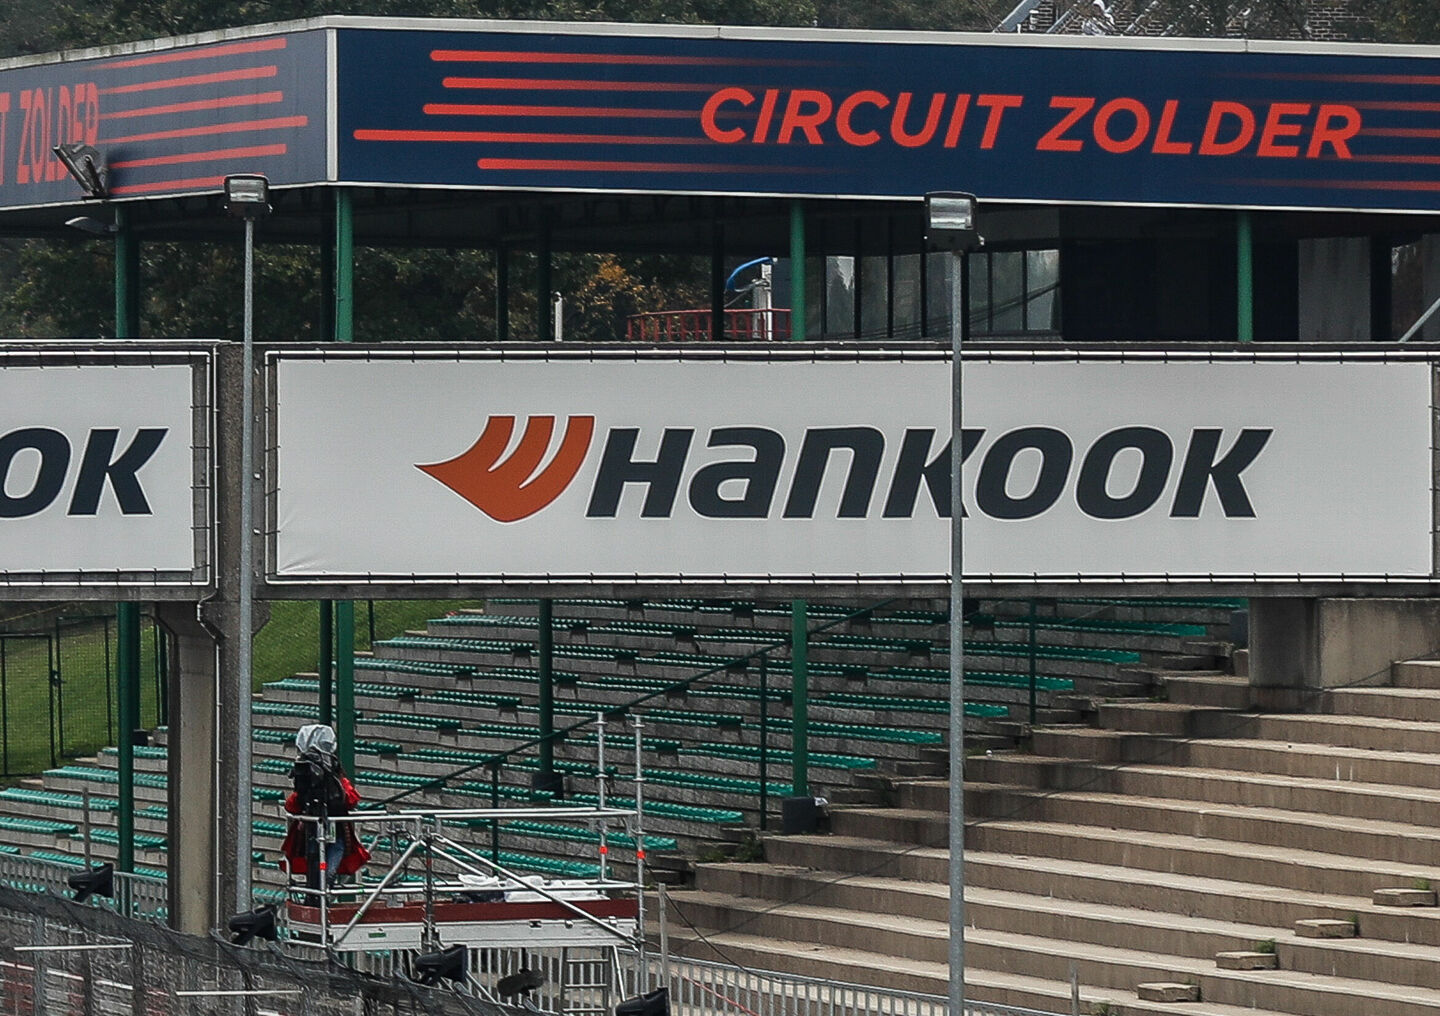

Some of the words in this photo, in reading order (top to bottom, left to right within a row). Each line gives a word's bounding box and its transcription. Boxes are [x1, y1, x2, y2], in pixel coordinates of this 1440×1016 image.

[17, 82, 100, 187] ZOLDER
[699, 86, 1023, 149] CIRCUIT
[1036, 95, 1362, 160] ZOLDER
